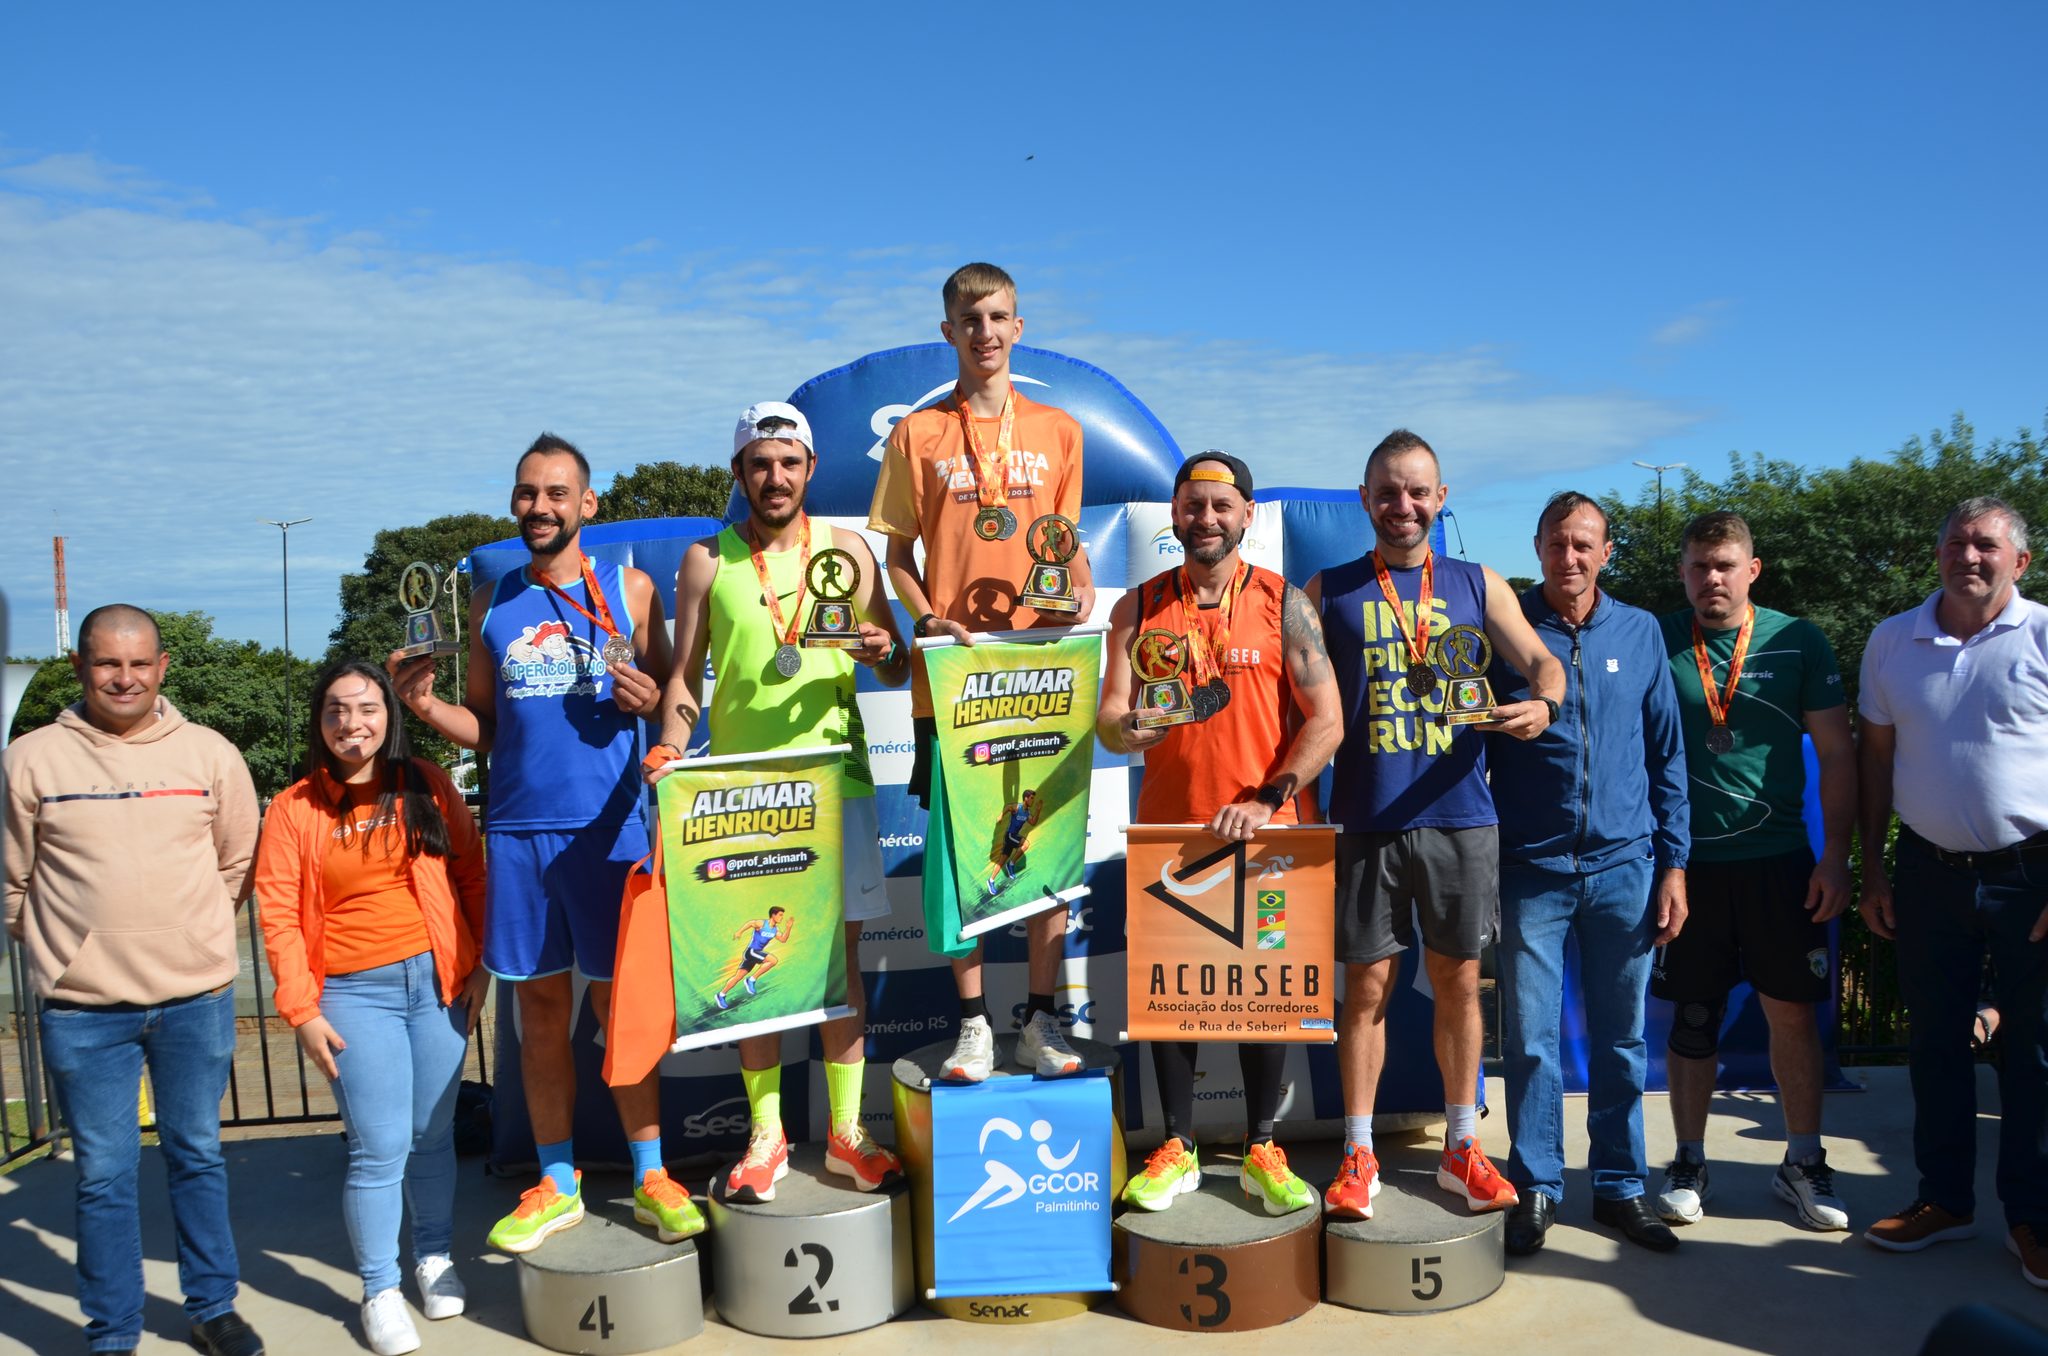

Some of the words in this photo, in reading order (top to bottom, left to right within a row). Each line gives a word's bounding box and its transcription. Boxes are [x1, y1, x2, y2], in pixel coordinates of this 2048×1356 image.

[960, 450, 1049, 471] RTICA
[944, 467, 1044, 489] REGNAL
[1247, 538, 1266, 551] RS
[1363, 598, 1450, 642] INS
[502, 663, 544, 680] SUPER
[962, 669, 1073, 700] ALCIMAR
[1368, 677, 1448, 715] ECO
[956, 693, 1071, 727] HENRIQUE
[990, 736, 1060, 754] @prof_alcimarh
[1368, 717, 1453, 755] RUN
[91, 781, 166, 792] PARIS
[692, 782, 813, 817] ALCIMAR
[685, 807, 813, 843] HENRIQUE
[726, 851, 808, 870] @prof_alcimarh
[1150, 963, 1319, 996] ACORSEB
[1147, 1000, 1216, 1014] Associação
[1220, 1000, 1243, 1012] dos
[1247, 1001, 1319, 1013] Corredores
[928, 1016, 948, 1030] RS
[1179, 1020, 1195, 1032] de
[1199, 1021, 1222, 1032] Rua
[1226, 1020, 1242, 1032] de
[1246, 1020, 1287, 1032] Seberi
[683, 1113, 751, 1138] Ses
[1028, 1172, 1099, 1194] GCOR
[1036, 1199, 1100, 1213] Palmitinho
[784, 1242, 839, 1315] 2
[1410, 1256, 1443, 1301] 5
[1178, 1253, 1231, 1328] 3
[579, 1295, 614, 1339] 4
[969, 1302, 1031, 1318] Senac
